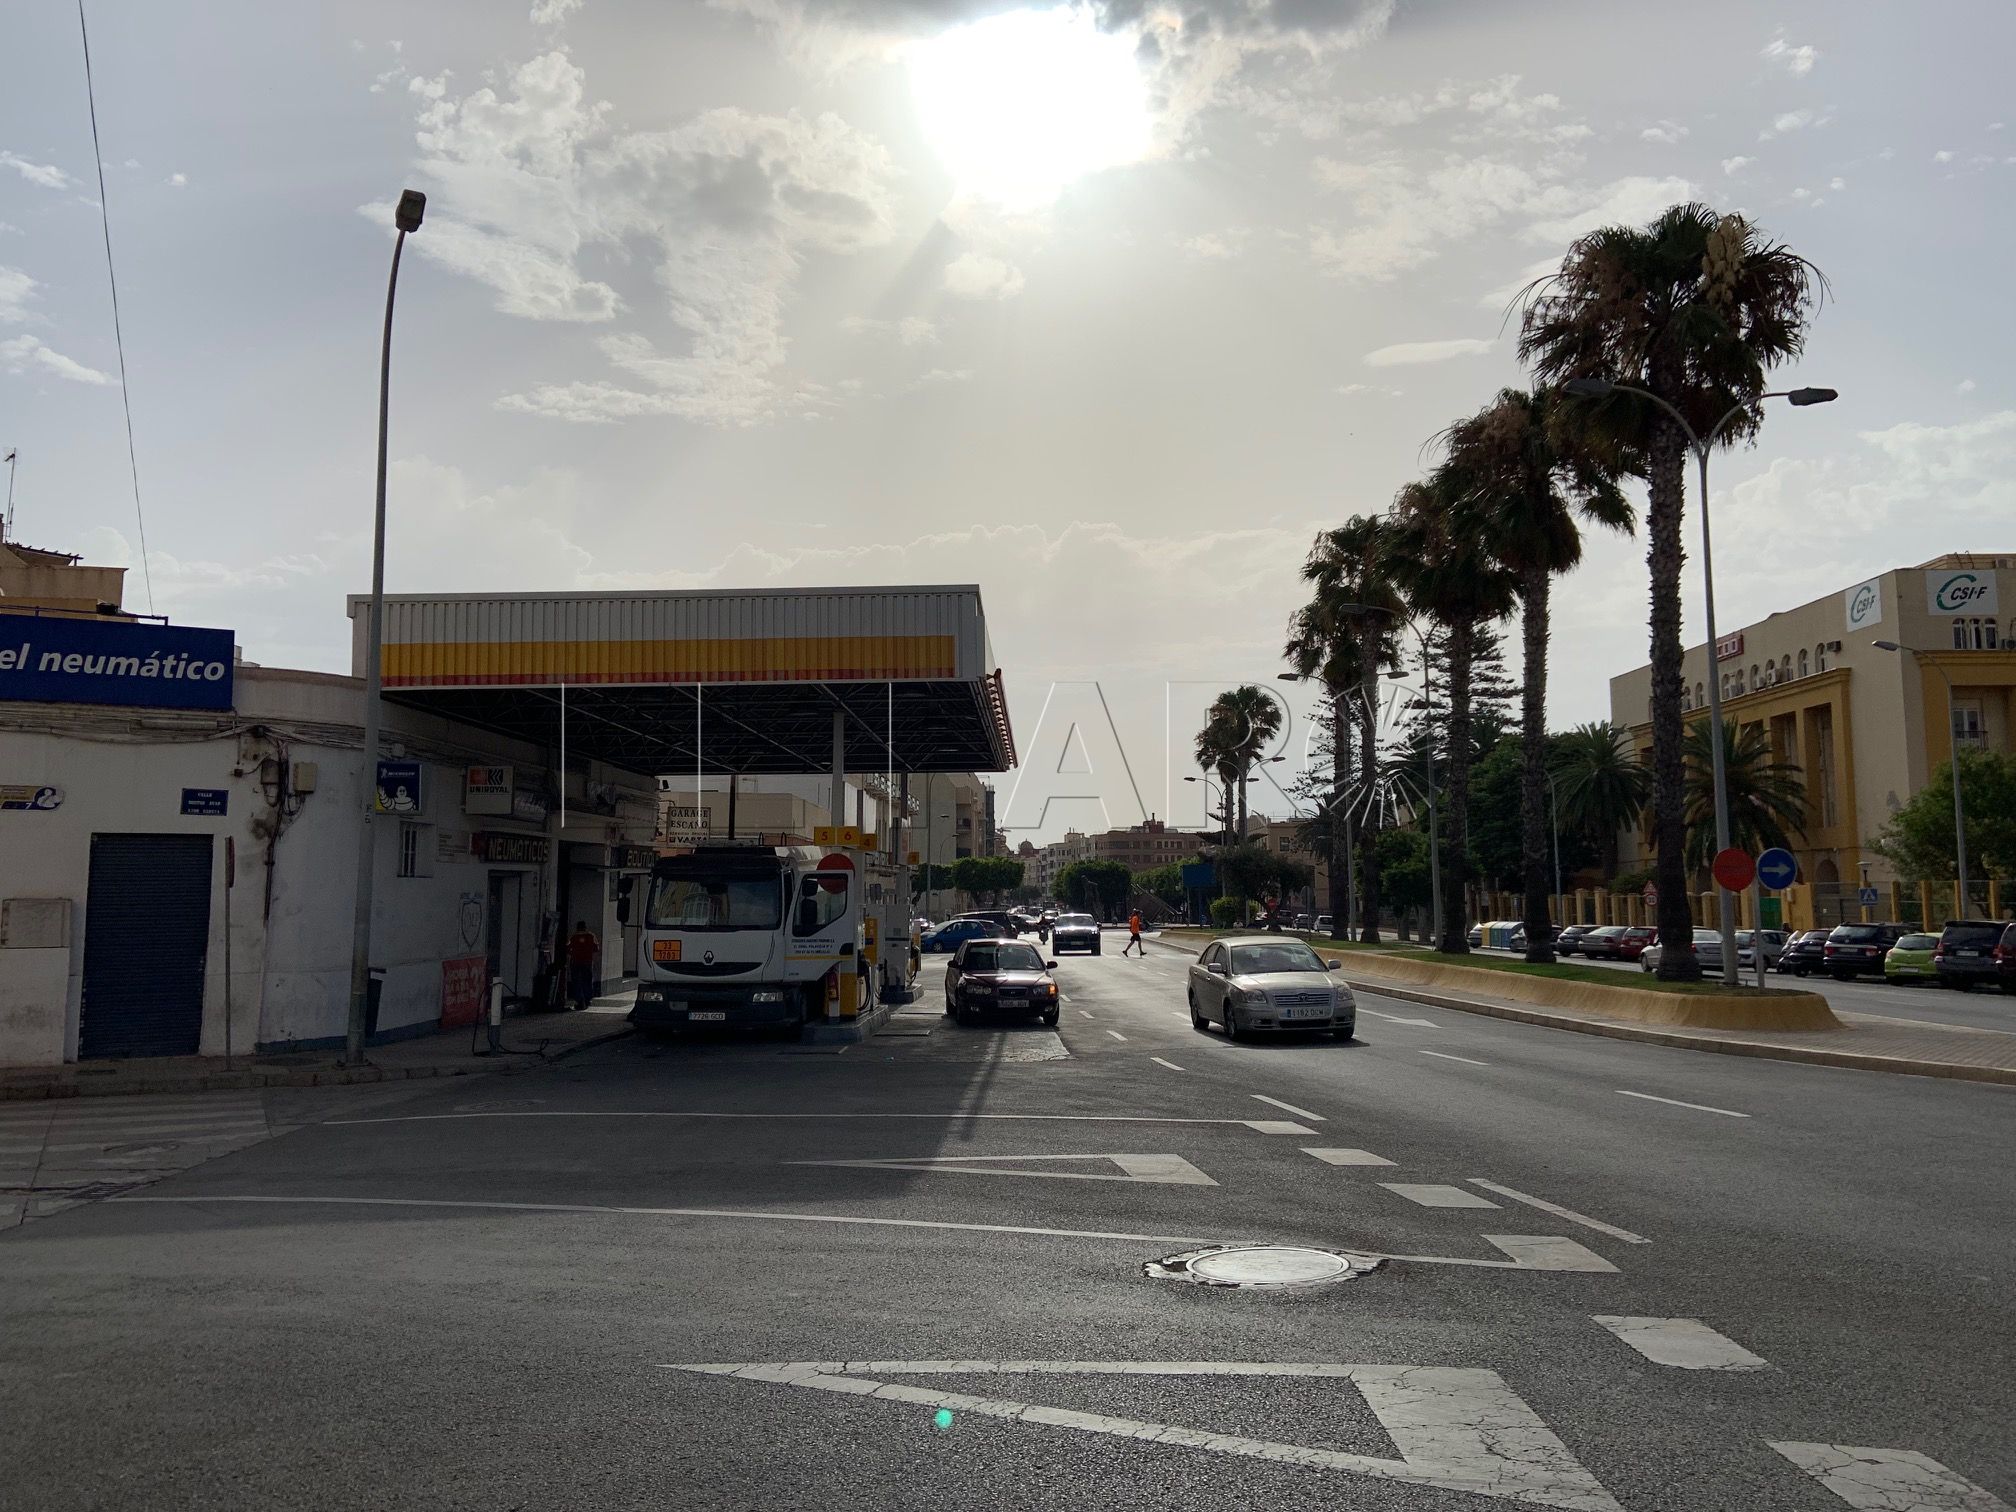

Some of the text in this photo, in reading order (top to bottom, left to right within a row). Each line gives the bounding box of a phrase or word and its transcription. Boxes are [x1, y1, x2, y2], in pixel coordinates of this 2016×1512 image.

[0, 643, 225, 681] el neumático
[469, 785, 509, 794] UNIROYAL
[671, 808, 708, 818] GARAGE
[821, 830, 852, 841] 5 6
[488, 837, 549, 863] NEUMATICOS
